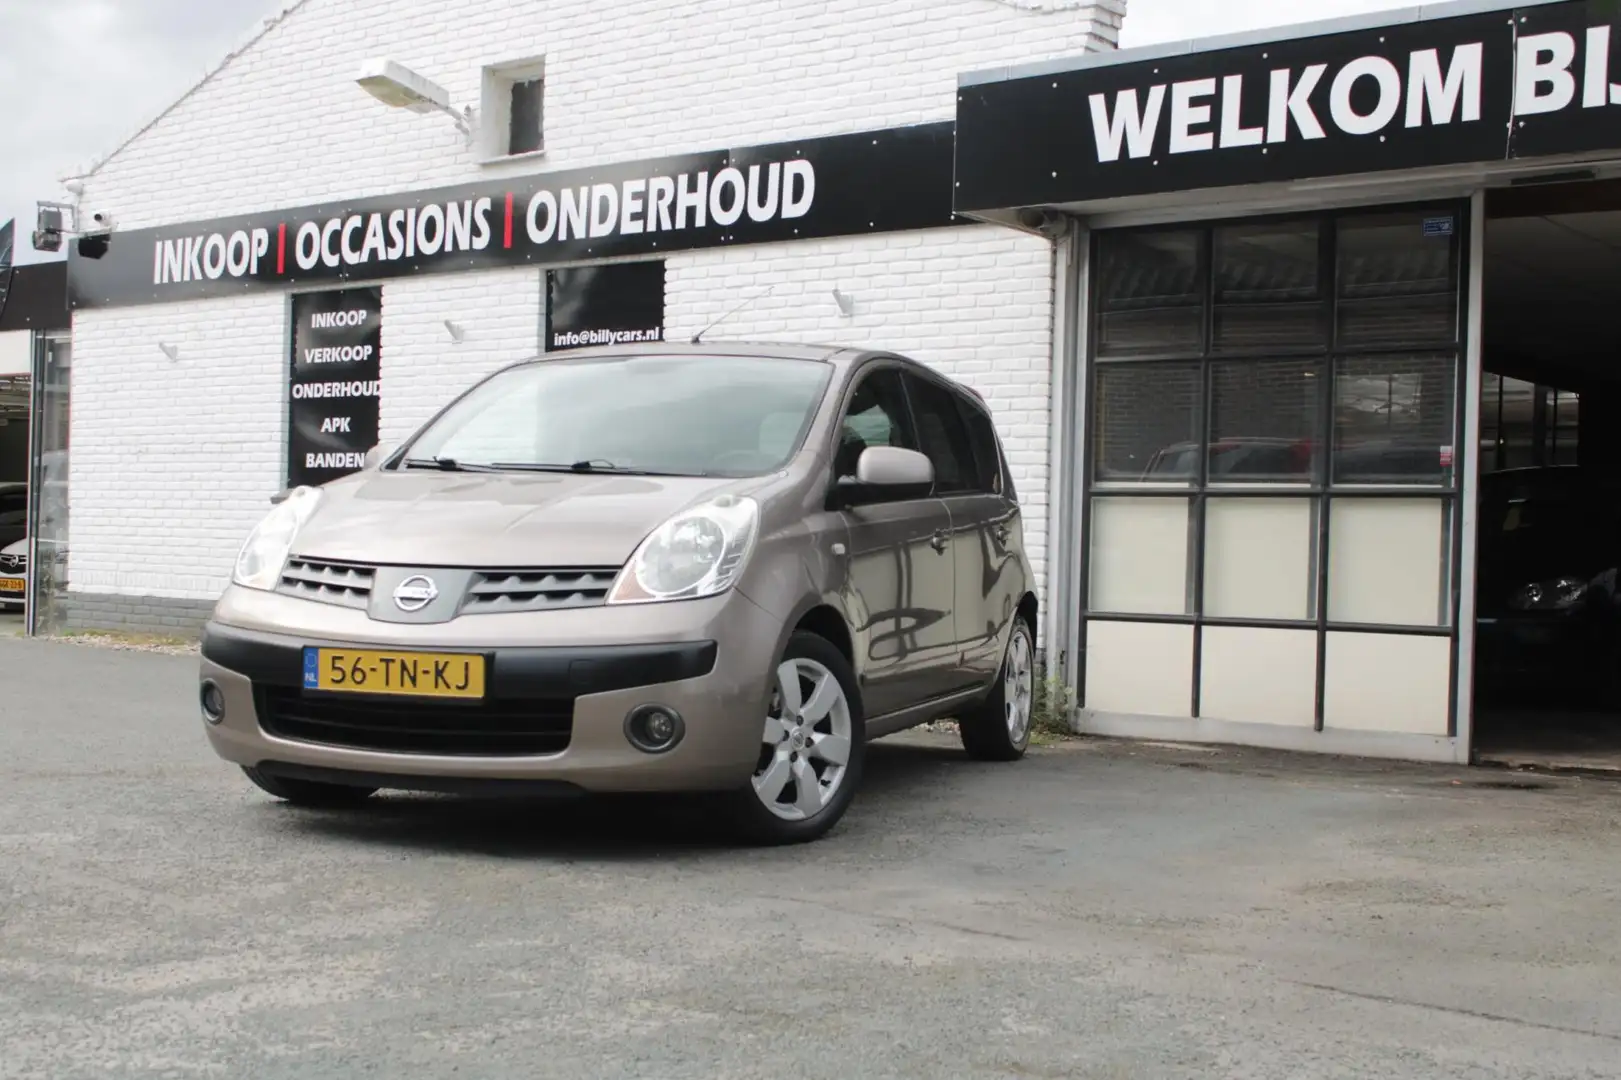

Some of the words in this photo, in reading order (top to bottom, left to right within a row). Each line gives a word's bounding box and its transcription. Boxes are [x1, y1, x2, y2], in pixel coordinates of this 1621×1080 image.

[1088, 42, 1483, 162] WELKOM
[1514, 25, 1621, 116] BI
[154, 228, 269, 284] INKOOP
[295, 197, 492, 270] OCCASIONS
[526, 159, 816, 244] ONDERHOUD
[311, 310, 367, 328] INKOOP
[554, 326, 659, 346] info@billycars.nl
[304, 345, 373, 363] VERKOOP
[292, 380, 380, 399] ONDERHOUD
[320, 417, 351, 433] APK
[305, 452, 365, 468] BANDEN
[304, 673, 317, 682] NL
[330, 655, 469, 690] 56-TN-KJ
